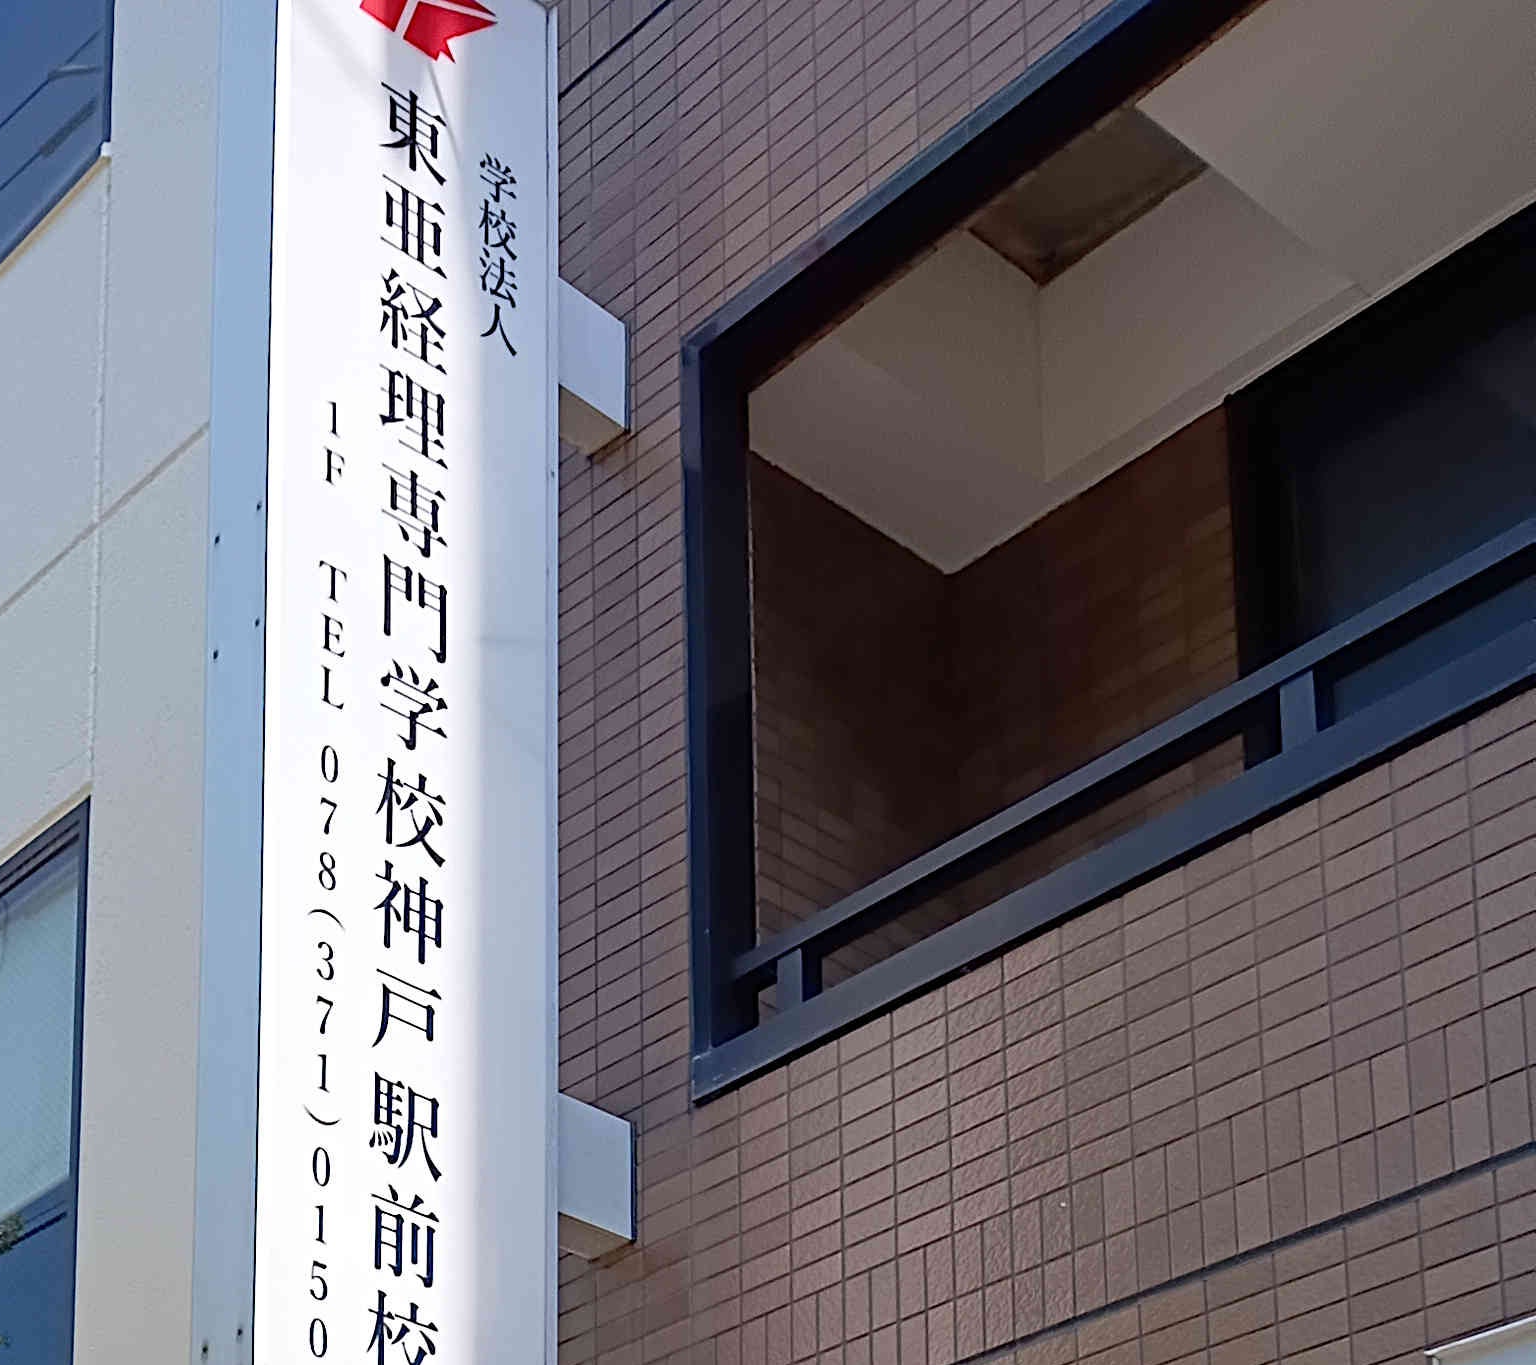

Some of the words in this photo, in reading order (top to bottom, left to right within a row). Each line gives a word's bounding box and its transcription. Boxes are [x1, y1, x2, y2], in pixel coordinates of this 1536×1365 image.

[478, 152, 519, 357] 学校法人
[323, 400, 346, 487] 1F
[317, 559, 349, 712] TEL
